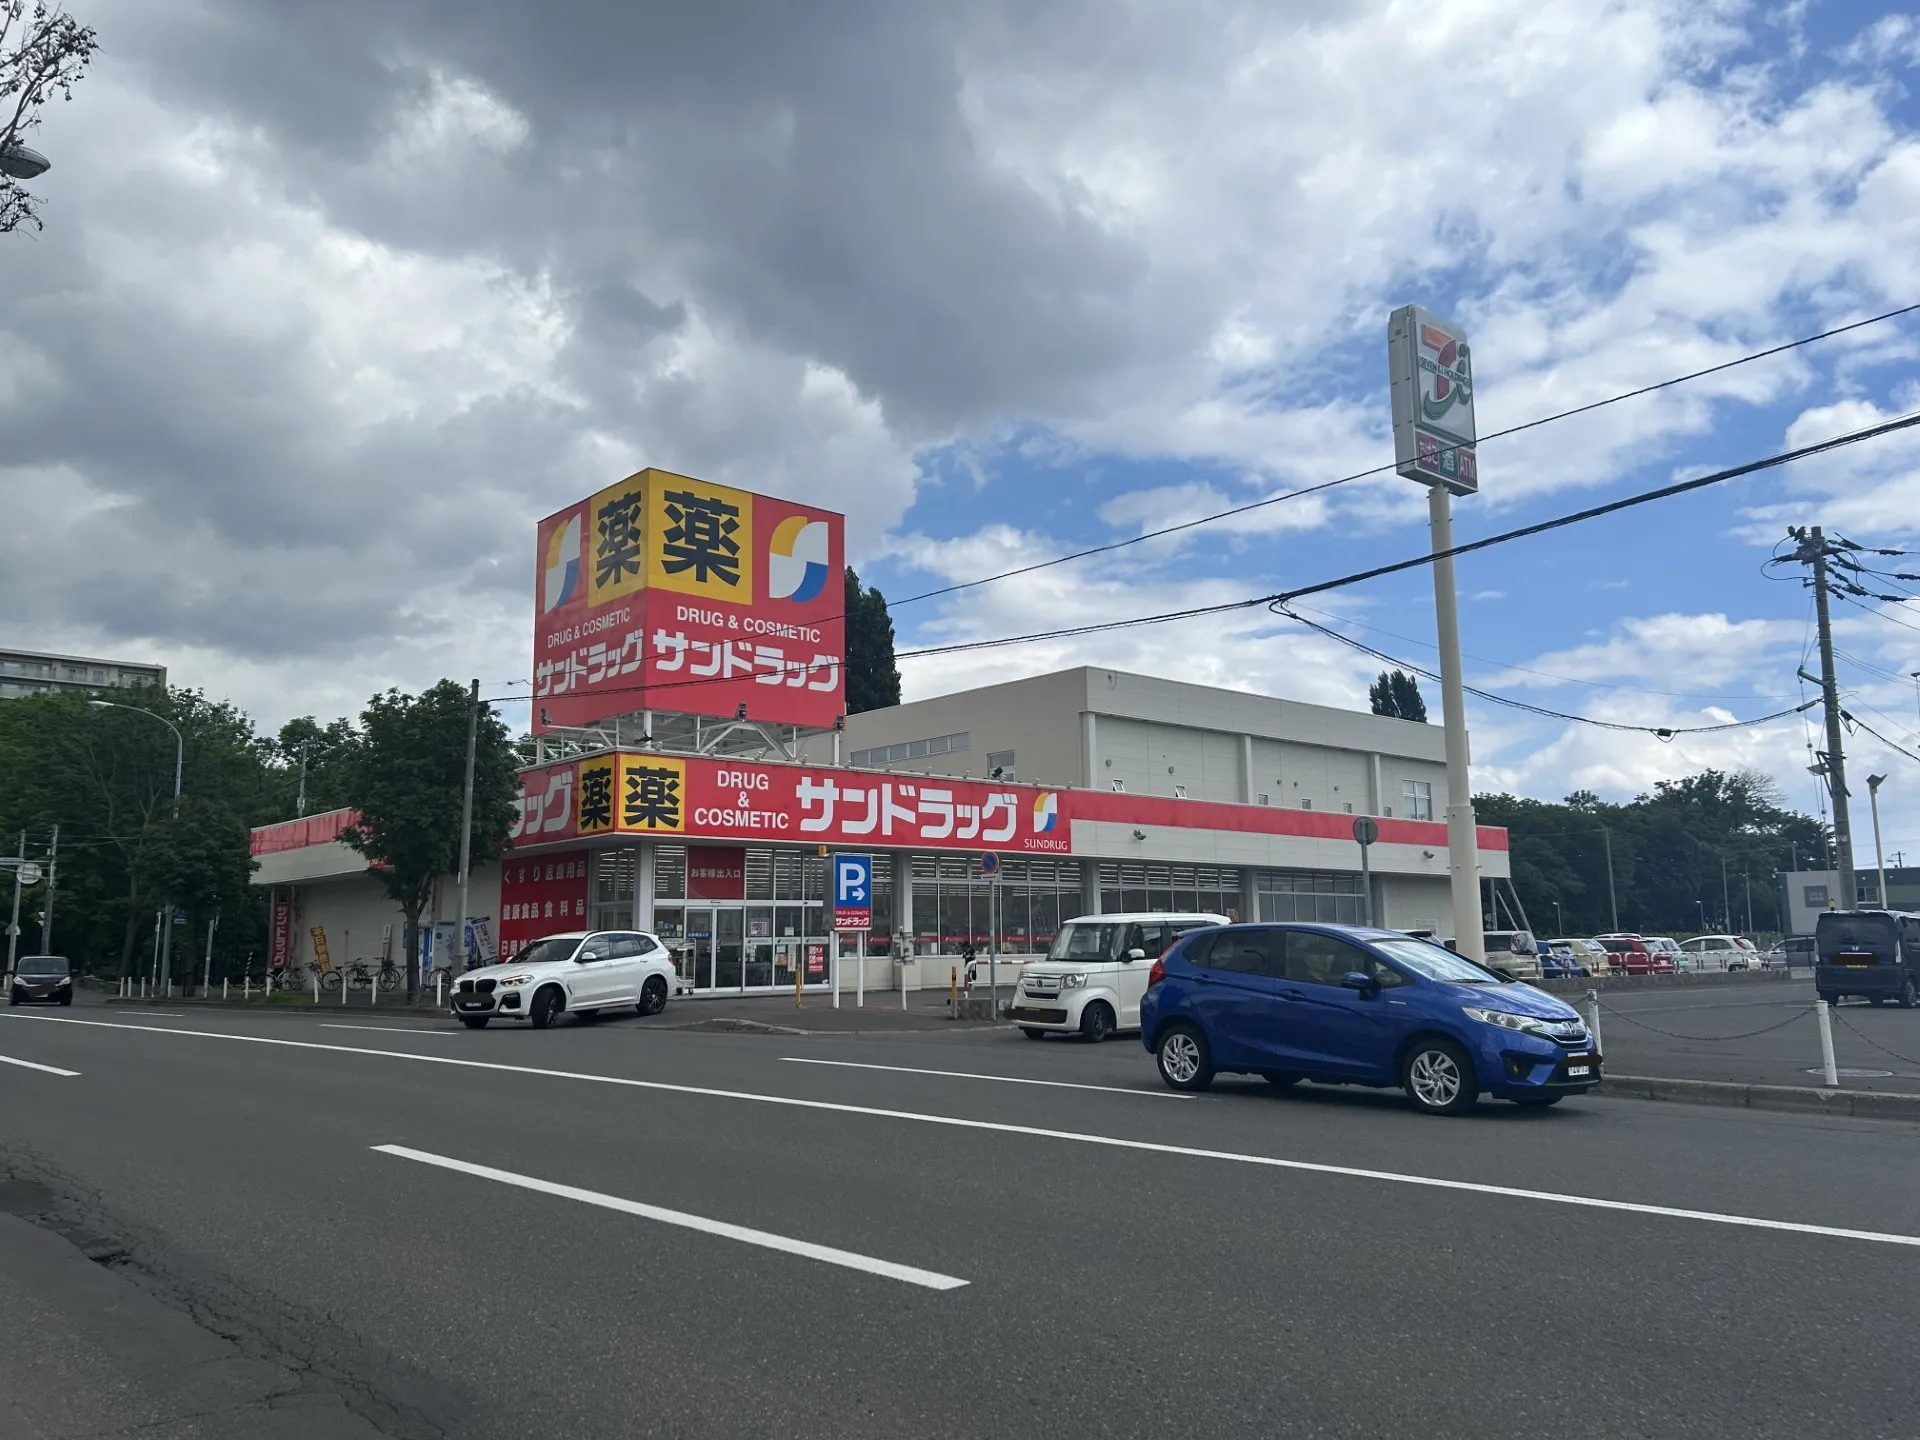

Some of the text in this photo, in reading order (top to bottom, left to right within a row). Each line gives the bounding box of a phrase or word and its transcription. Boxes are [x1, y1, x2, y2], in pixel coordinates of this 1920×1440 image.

[1442, 448, 1454, 471] 酒
[1460, 455, 1476, 480] ATM
[595, 491, 642, 589] 薬
[661, 490, 741, 586] 薬
[547, 607, 630, 649] DRUG & COSMETIC
[677, 606, 821, 644] DRUG & COSMETIC
[536, 628, 643, 698] サンドラッグ
[652, 628, 839, 692] サンドラッグ
[717, 770, 769, 791] DRUG
[580, 767, 611, 830] 薬
[624, 766, 680, 828] 薬
[738, 791, 750, 808] &
[796, 776, 1018, 842] サンドラッグ
[694, 807, 789, 829] COSMETIC
[1024, 838, 1068, 851] SUNDRUG
[504, 865, 540, 884] くすり
[690, 868, 741, 879] お客様出入口
[840, 863, 866, 901] P
[503, 899, 584, 921] 健康食品 食料品
[835, 916, 869, 926] サンドラッグ
